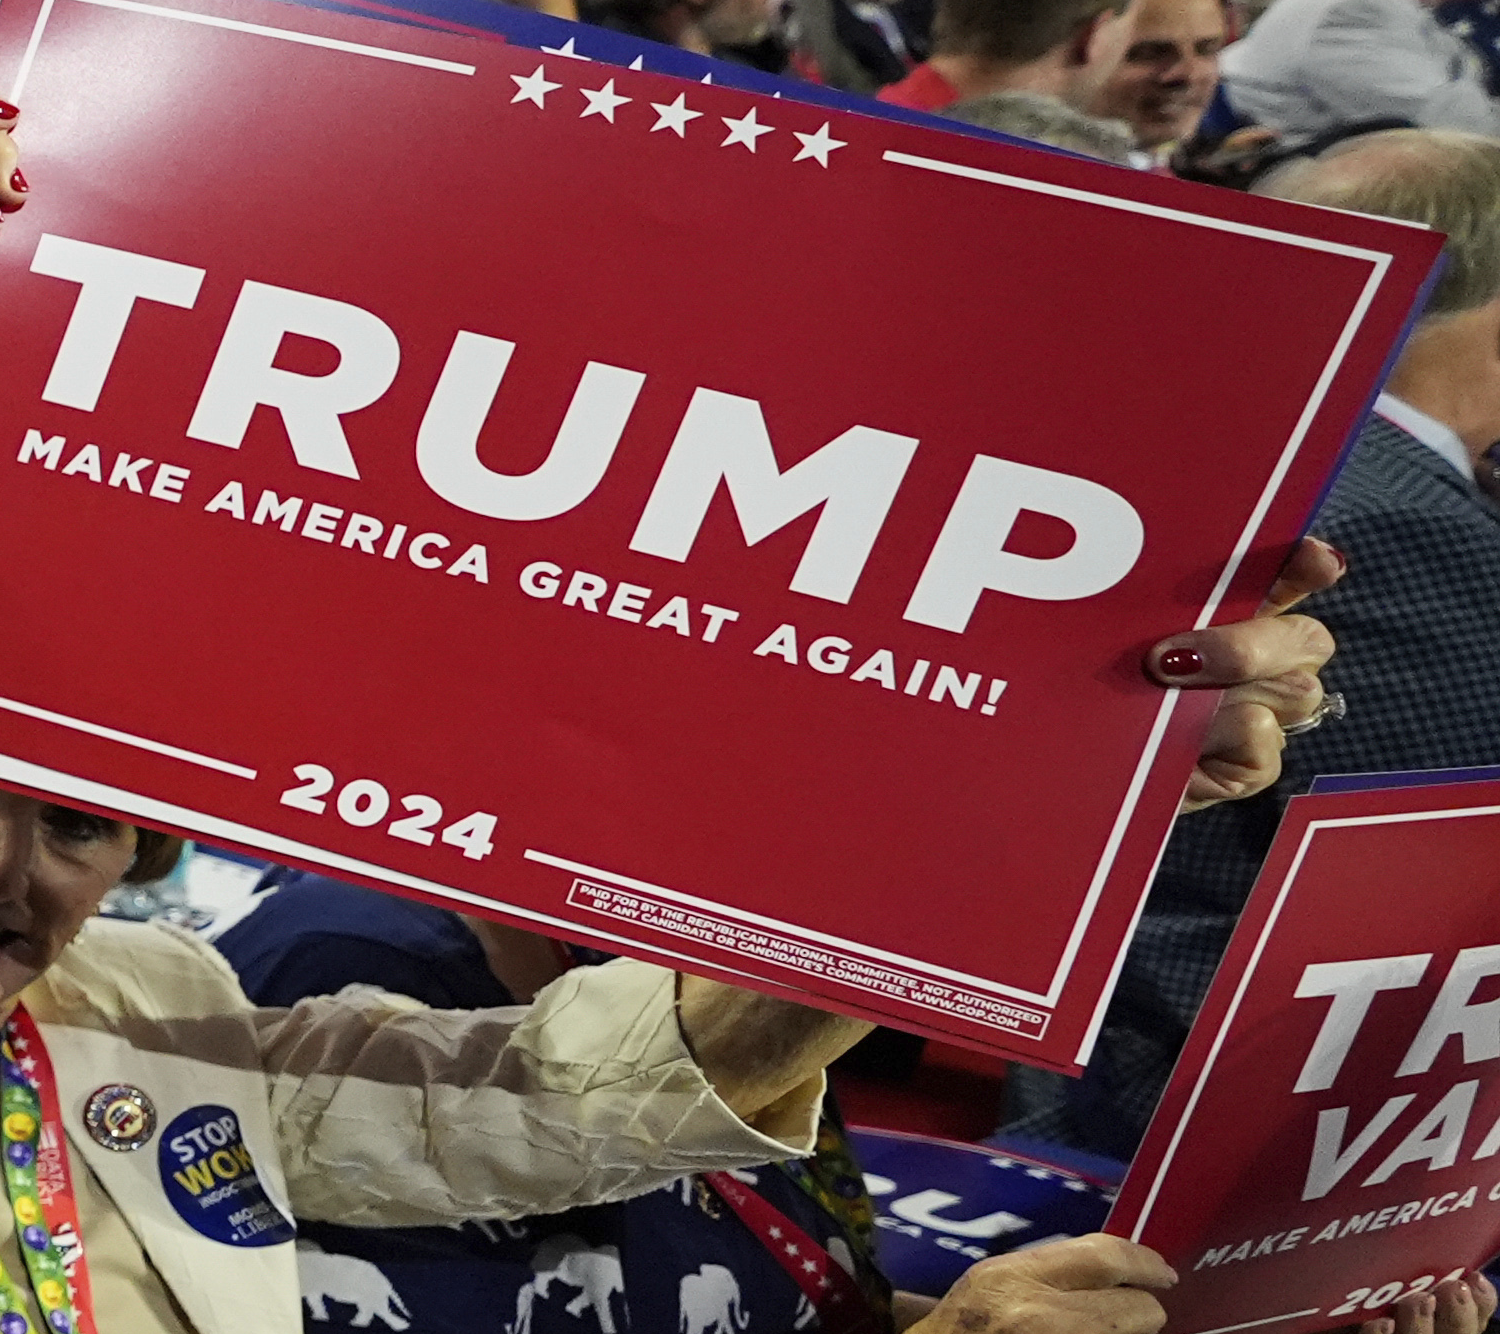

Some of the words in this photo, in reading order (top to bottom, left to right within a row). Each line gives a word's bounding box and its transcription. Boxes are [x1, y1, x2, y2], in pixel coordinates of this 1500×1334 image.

[28, 231, 1145, 634] TRUMP
[17, 428, 191, 504] MAKE
[204, 478, 492, 585] AMERICA
[519, 560, 739, 644] GREAT
[754, 620, 1007, 717] AGAIN!
[277, 762, 498, 864] 2024
[580, 885, 611, 902] PAID
[611, 893, 638, 909] FOR
[640, 901, 659, 914] BY
[660, 907, 686, 922] THE
[686, 915, 769, 946] REPUBLICAN
[769, 933, 836, 966] NATIONAL
[838, 955, 920, 989] COMMITTEE.
[922, 983, 953, 998] NOT
[953, 992, 1043, 1025] AUTHORIZED
[592, 899, 611, 911] BY
[611, 903, 641, 919] ANY
[641, 912, 714, 942] CANDIDATE
[716, 933, 736, 947] OR
[737, 939, 823, 973] CANDIDATE'S
[825, 965, 907, 997] COMMITTEE.
[910, 988, 1021, 1029] WWW.GOP.COM
[1292, 943, 1500, 1094] TR
[169, 1115, 239, 1164] STOP
[172, 1141, 255, 1197] WOK
[1301, 1078, 1500, 1202] VA
[1193, 1226, 1311, 1271] MAKE
[1310, 1185, 1479, 1246] AMERICA
